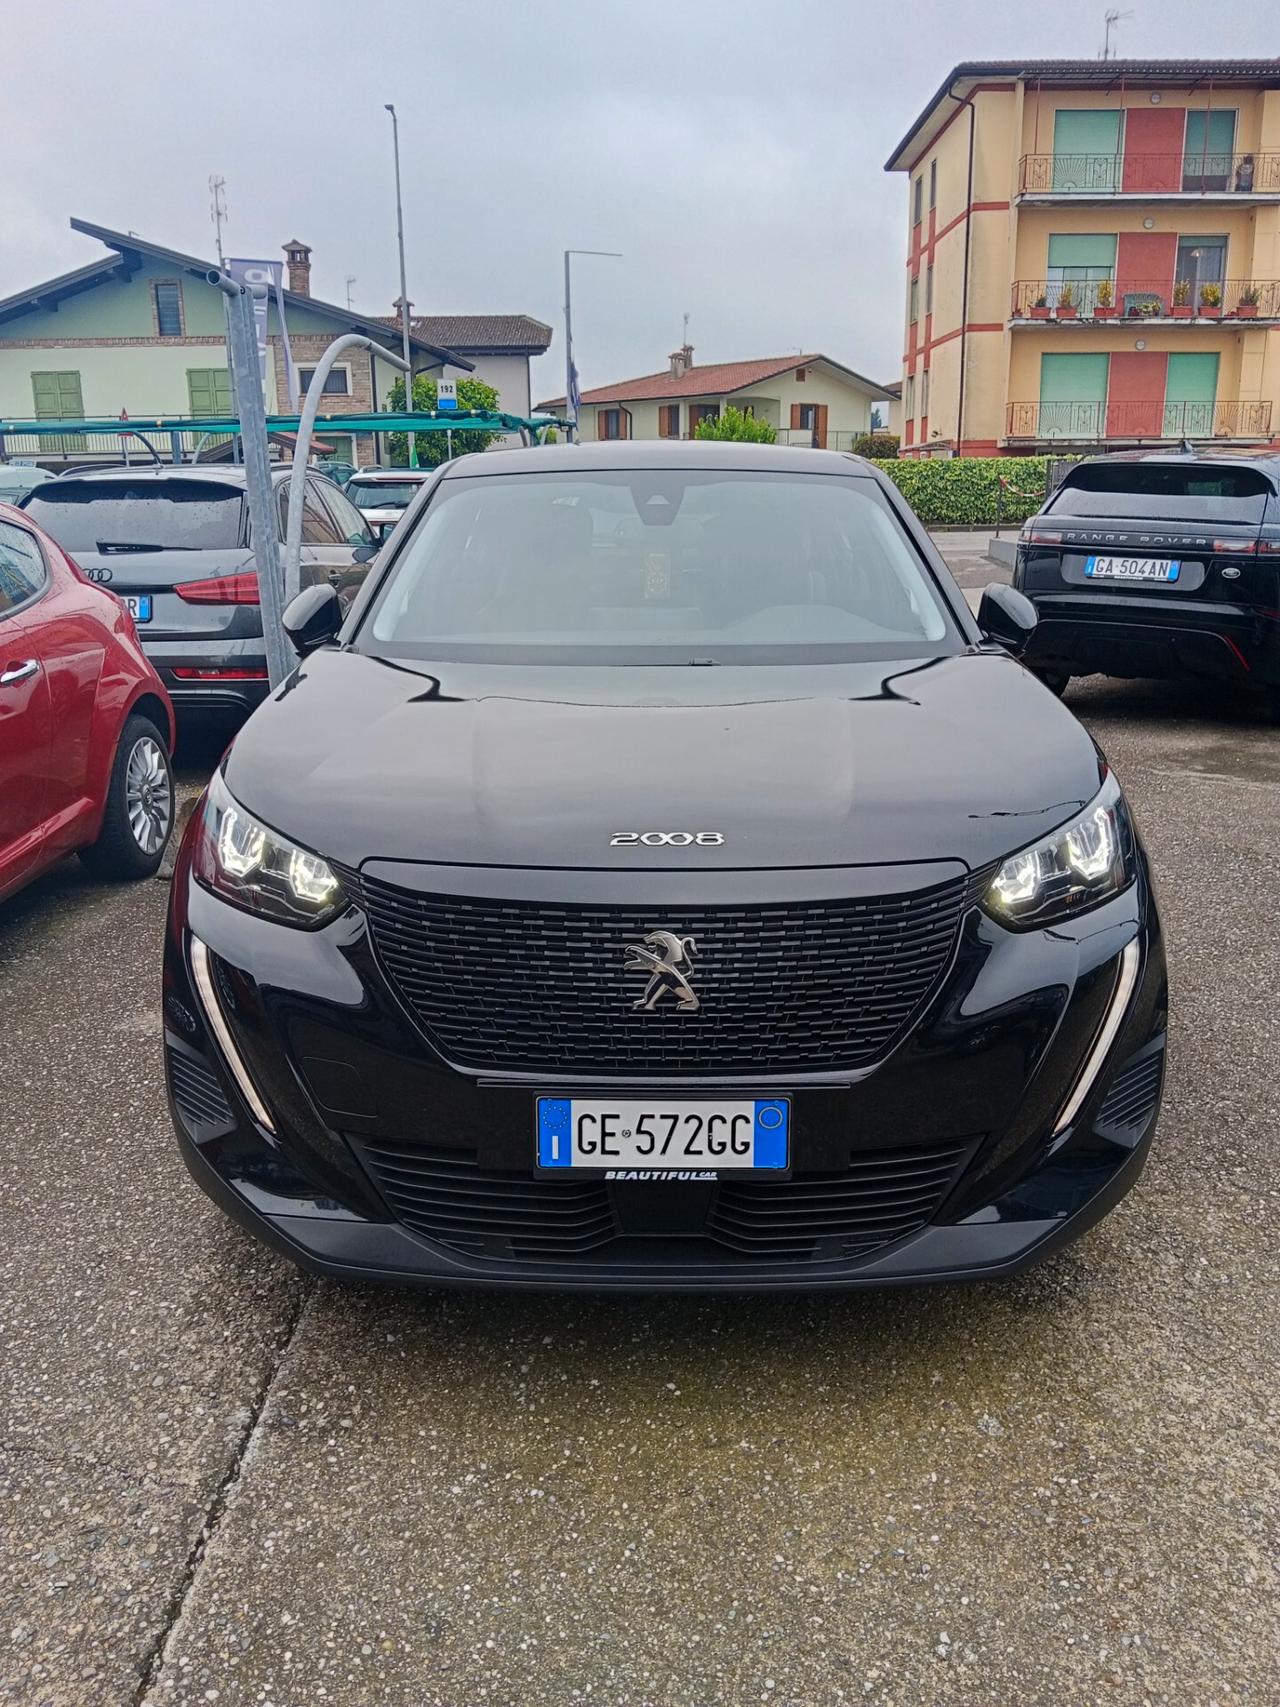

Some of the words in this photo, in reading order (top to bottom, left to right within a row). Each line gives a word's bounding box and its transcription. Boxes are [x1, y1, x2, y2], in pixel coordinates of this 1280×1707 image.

[440, 385, 454, 393] 192
[1067, 533, 1128, 542] RANGE
[1140, 536, 1207, 545] ROVER
[610, 832, 725, 846] 2008
[577, 1113, 621, 1155] GE
[635, 1113, 751, 1156] 572GG
[604, 1171, 698, 1180] BEAUTIFUL
